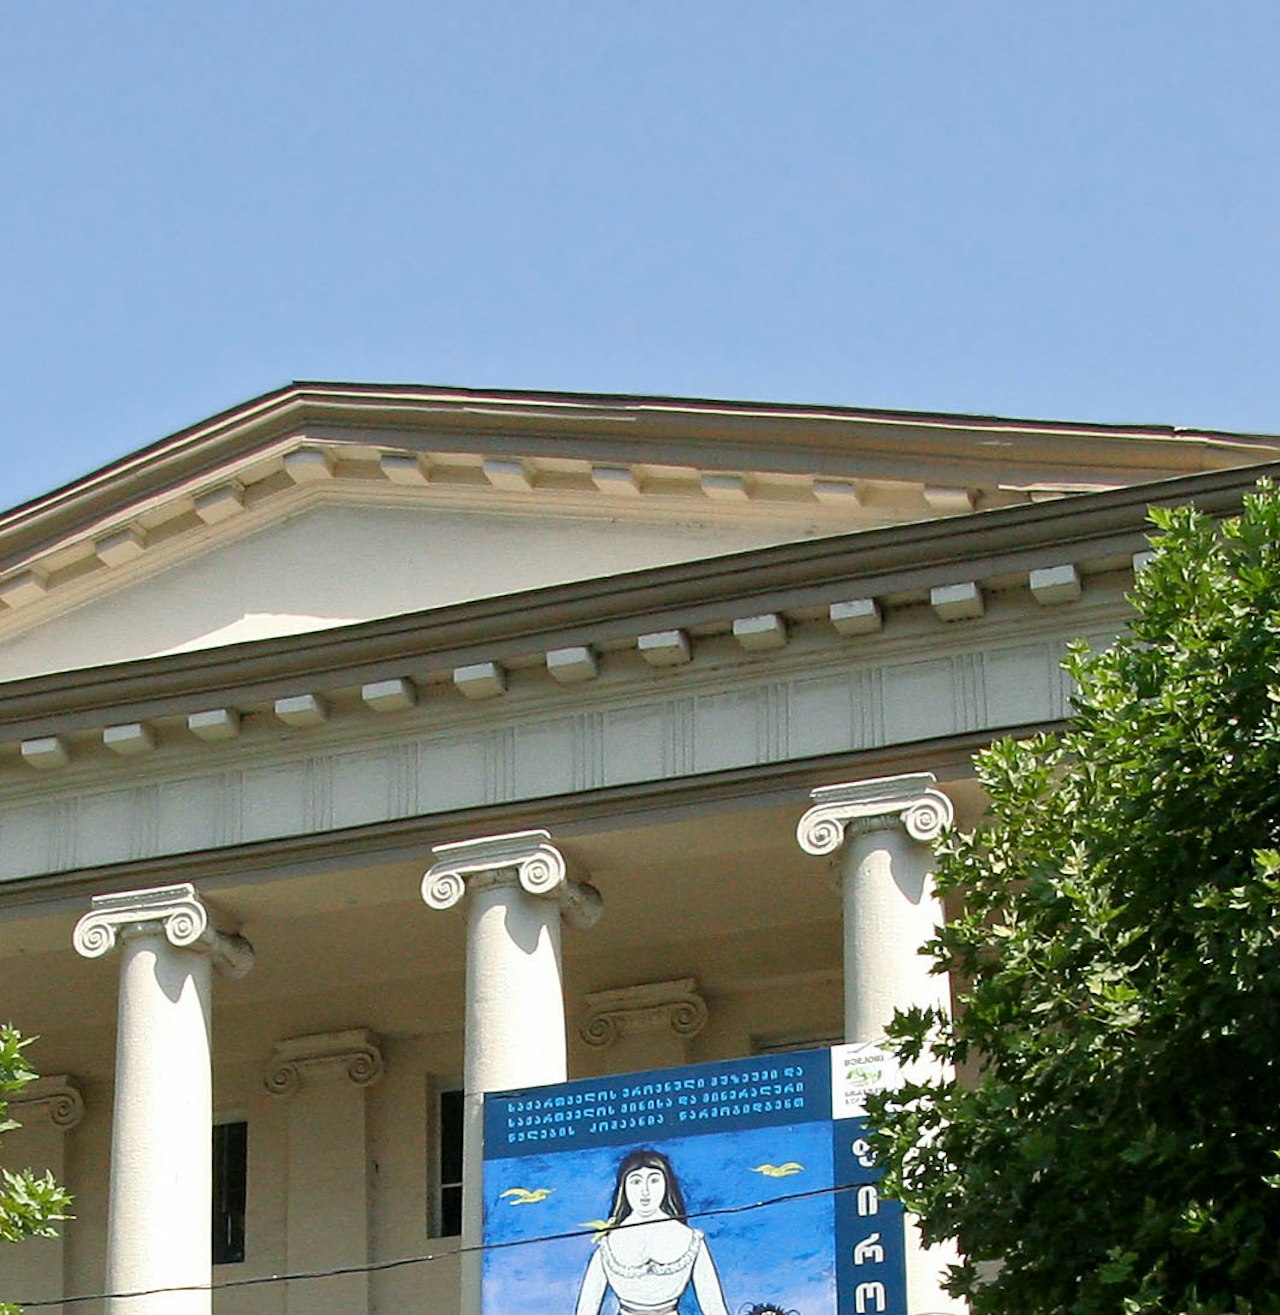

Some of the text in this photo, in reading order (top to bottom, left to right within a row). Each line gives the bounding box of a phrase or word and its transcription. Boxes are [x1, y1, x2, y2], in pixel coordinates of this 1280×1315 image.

[507, 1066, 803, 1113] საქართველოს ეროვნული მუზეუმი და
[507, 1082, 804, 1128] საქართველოს მინისა და მინერალური
[589, 1114, 664, 1133] კომპანია
[679, 1097, 804, 1121] წარმოგიდგენთ
